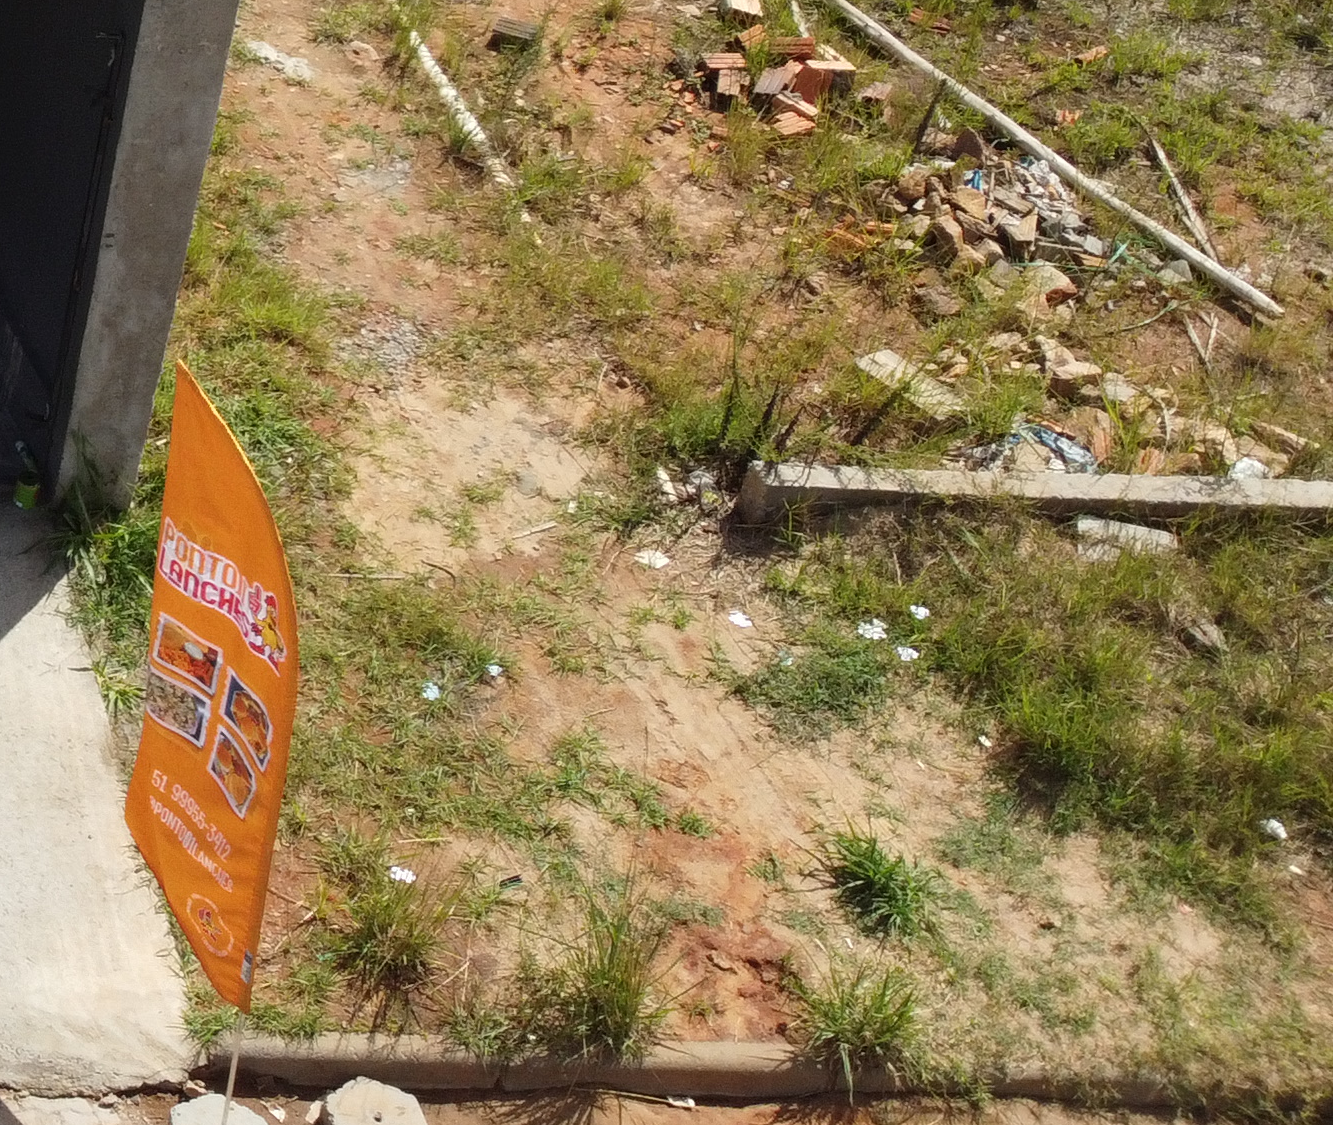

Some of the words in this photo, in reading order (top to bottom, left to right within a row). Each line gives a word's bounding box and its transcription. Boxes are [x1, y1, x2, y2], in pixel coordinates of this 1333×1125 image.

[163, 522, 238, 589] PONTO
[159, 545, 250, 638] LANCHES
[151, 769, 168, 793] 51
